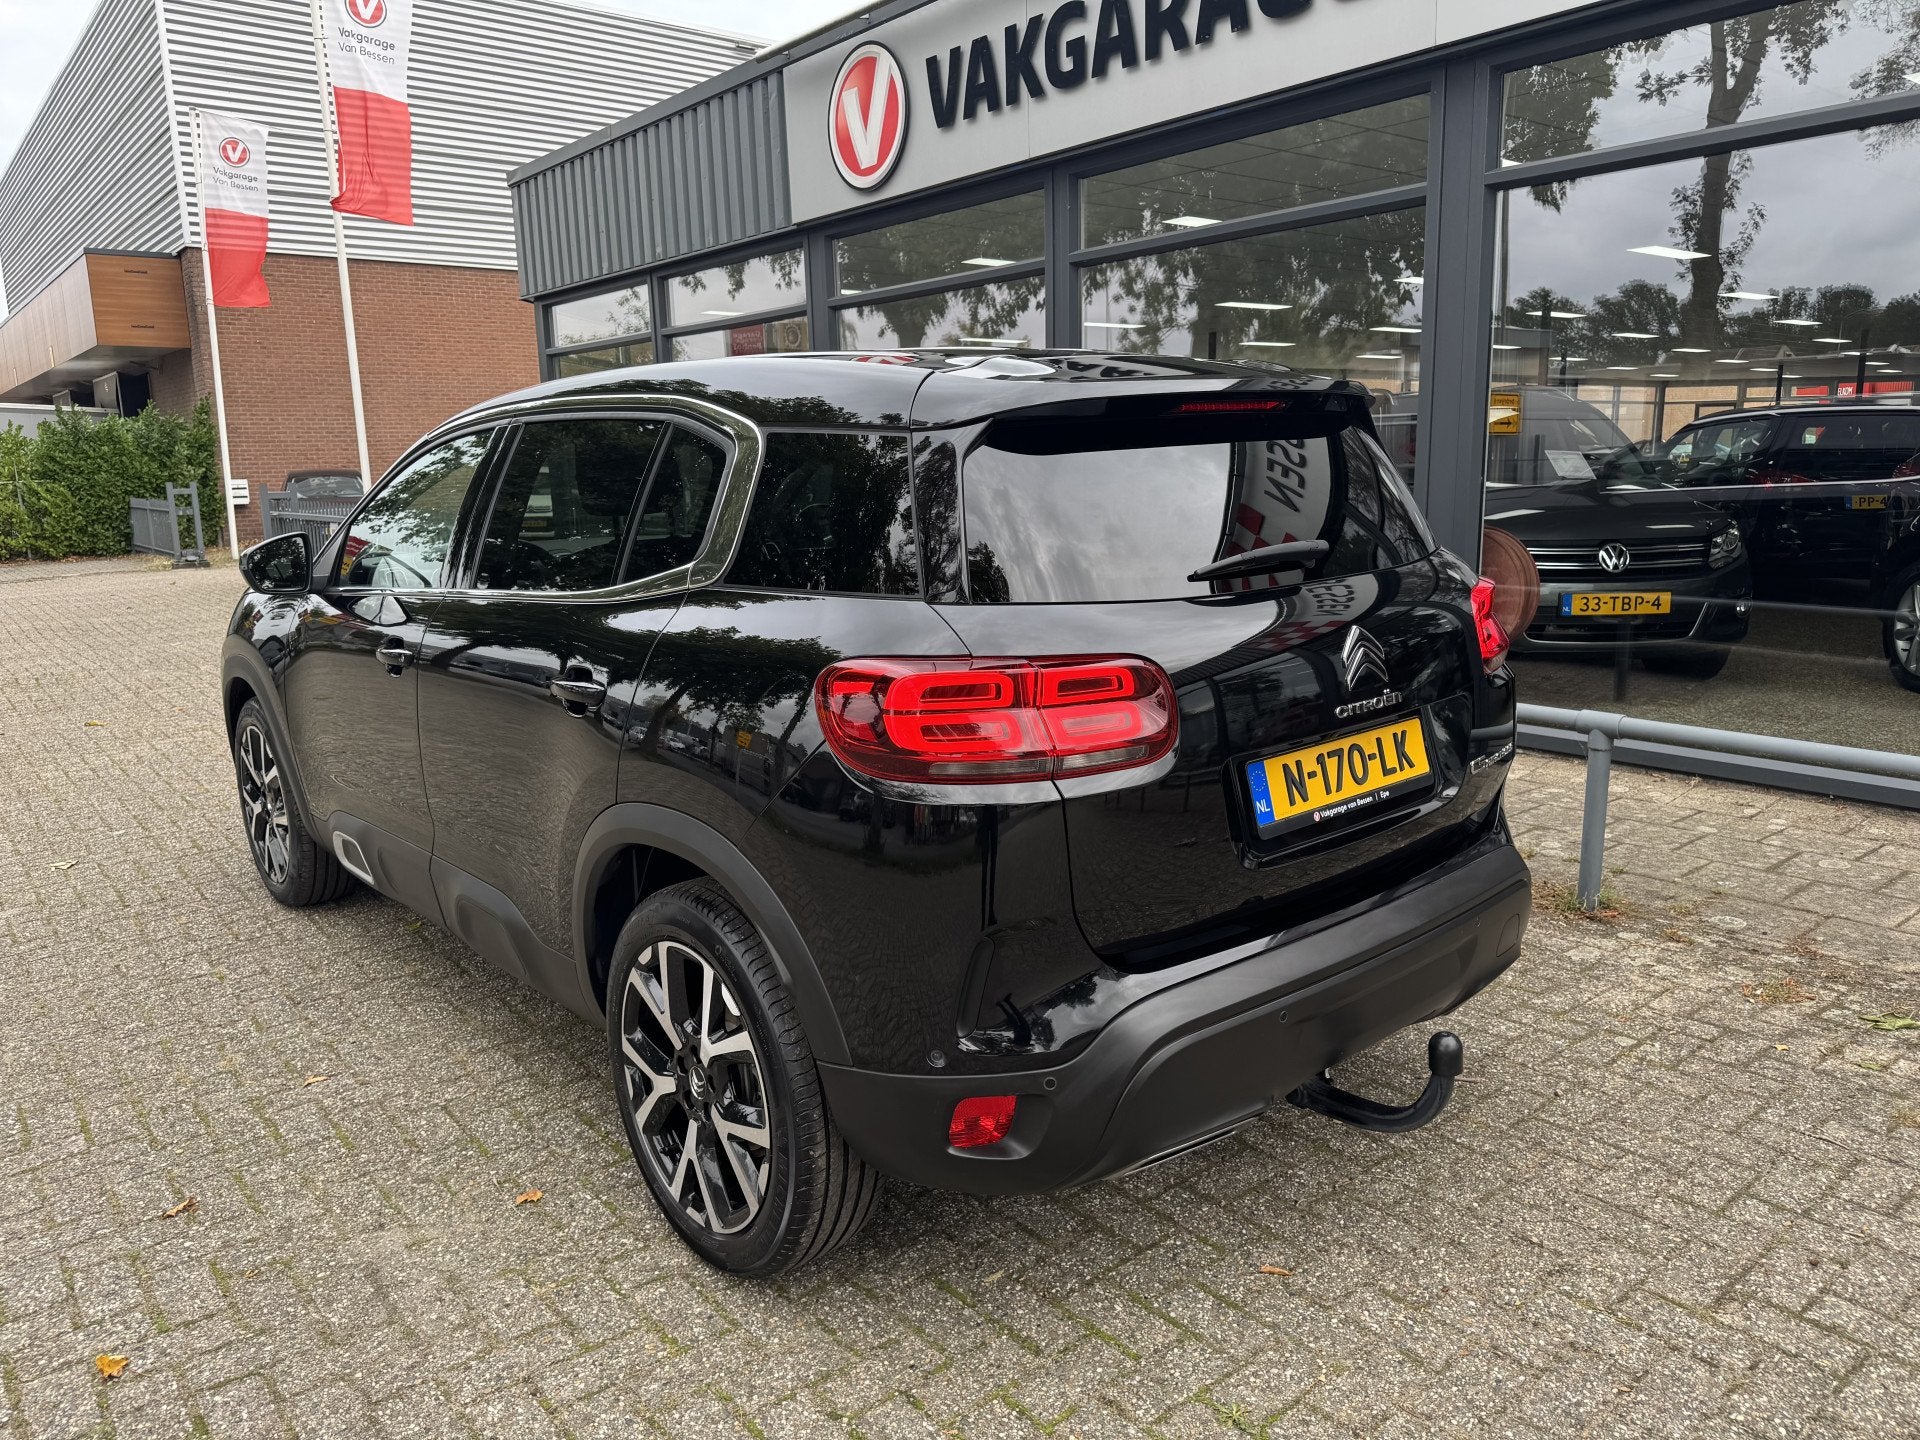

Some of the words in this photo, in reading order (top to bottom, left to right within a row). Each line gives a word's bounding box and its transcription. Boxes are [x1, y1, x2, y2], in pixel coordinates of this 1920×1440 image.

[338, 27, 395, 50] Vakgarage
[338, 42, 357, 53] Van
[360, 46, 395, 64] Bessen
[926, 0, 1313, 129] VAKGARA
[213, 166, 258, 182] Vakgarage
[213, 176, 228, 186] Van
[1579, 595, 1662, 612] 33-TBP-4
[1334, 688, 1403, 719] CITROËN
[1281, 729, 1416, 807] N-170-LK
[1255, 798, 1271, 815] NL
[1319, 805, 1348, 819] Vakgarage
[1380, 790, 1390, 799] Epe
